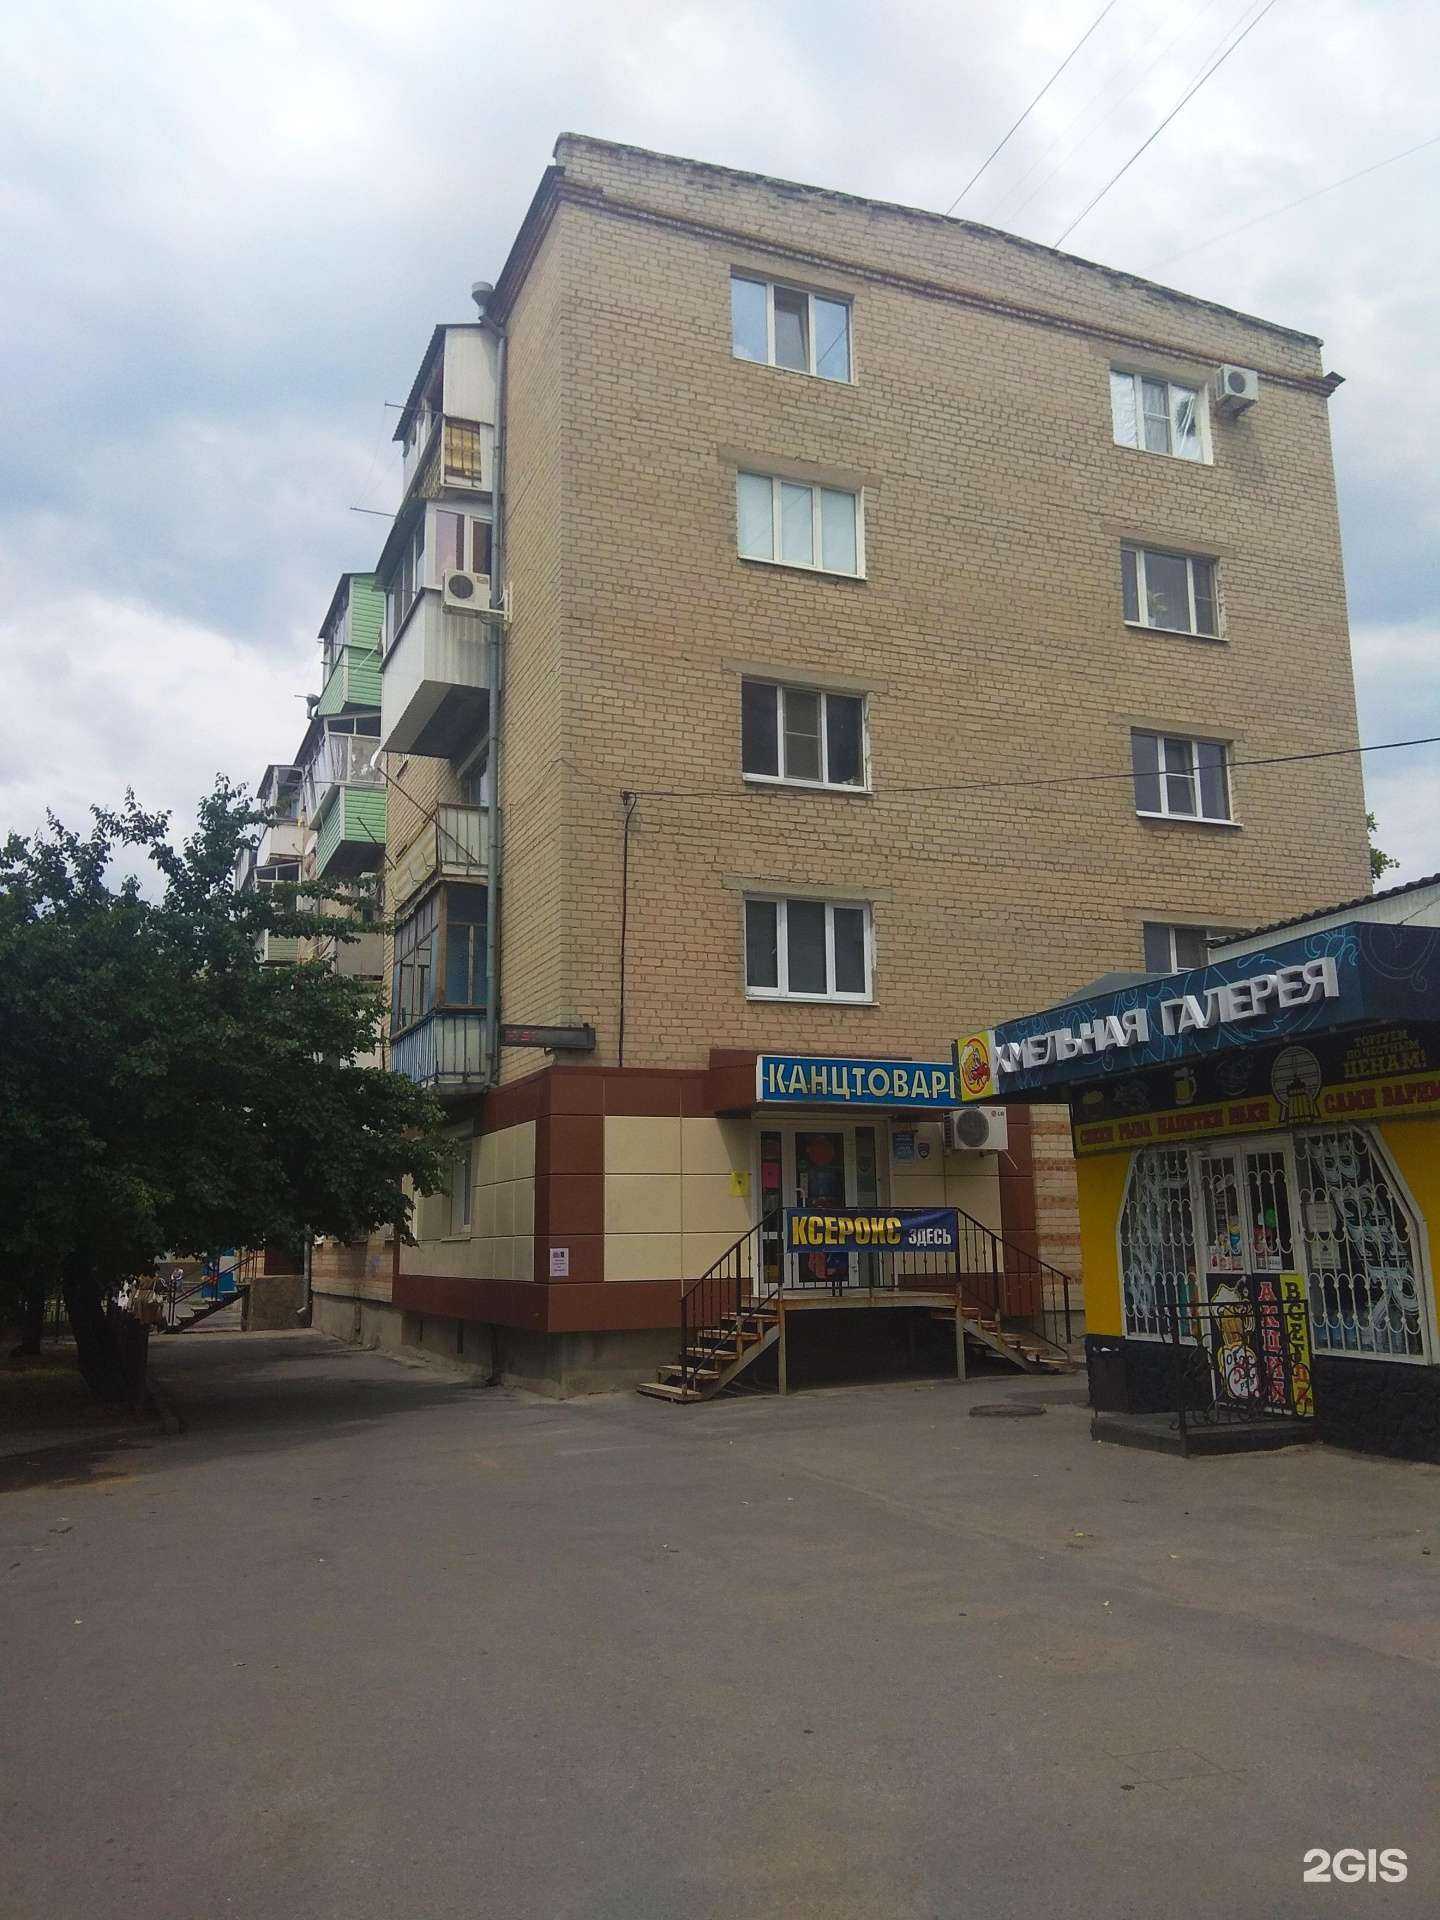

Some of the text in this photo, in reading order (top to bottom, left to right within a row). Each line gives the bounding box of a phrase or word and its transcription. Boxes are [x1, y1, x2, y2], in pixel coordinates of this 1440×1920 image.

[1160, 957, 1340, 1035] ГАЛЕРЕЯ
[792, 1215, 952, 1247] КСЕРОКС ЗДЕСЬ
